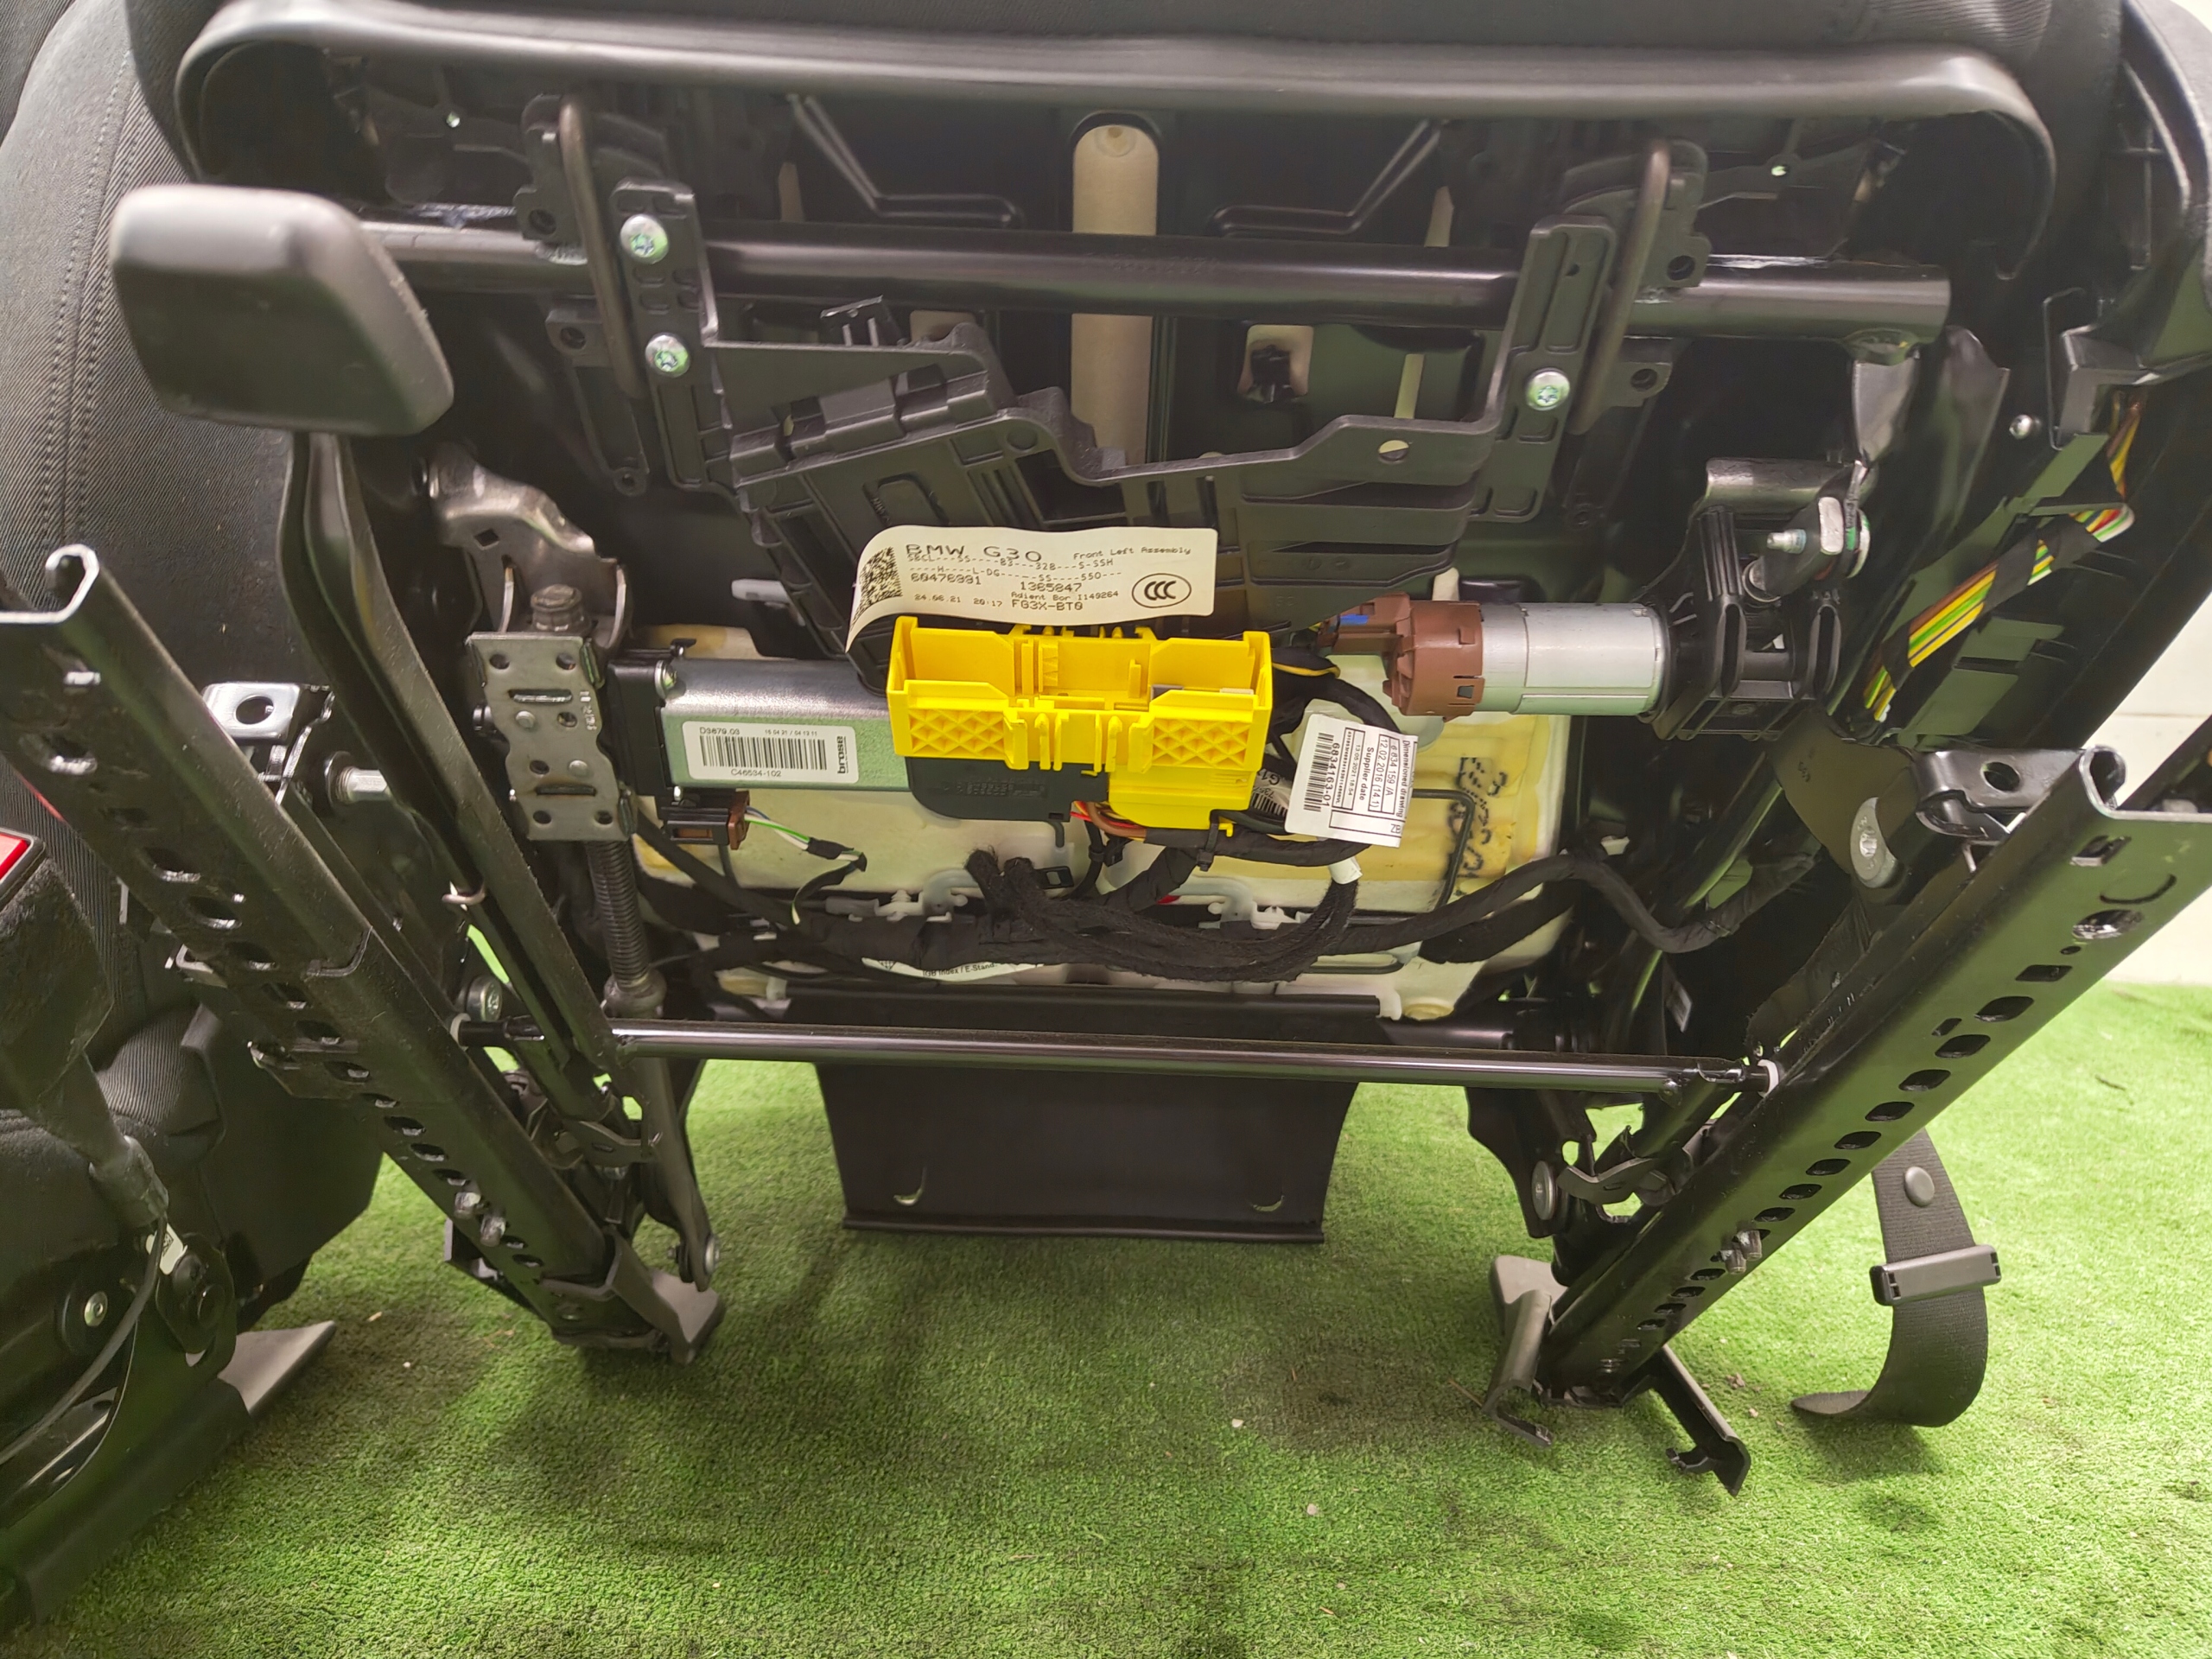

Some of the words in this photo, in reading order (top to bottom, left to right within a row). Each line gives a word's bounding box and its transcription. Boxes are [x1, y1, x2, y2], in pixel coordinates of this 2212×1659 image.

[906, 543, 965, 556] BMW
[982, 545, 1042, 563] G30
[1073, 550, 1103, 560] Front
[1110, 547, 1135, 556] Left
[1141, 546, 1192, 555] Assembly
[836, 735, 846, 774] brose
[1362, 747, 1375, 781] Supplier
[1374, 738, 1389, 782] 12.02.2016
[1389, 752, 1398, 767] 834
[1400, 740, 1410, 787] Dimensioned
[1321, 742, 1340, 807] 6834163-01
[1386, 770, 1396, 784] 159
[1358, 783, 1368, 801] date
[1396, 788, 1407, 817] drawing
